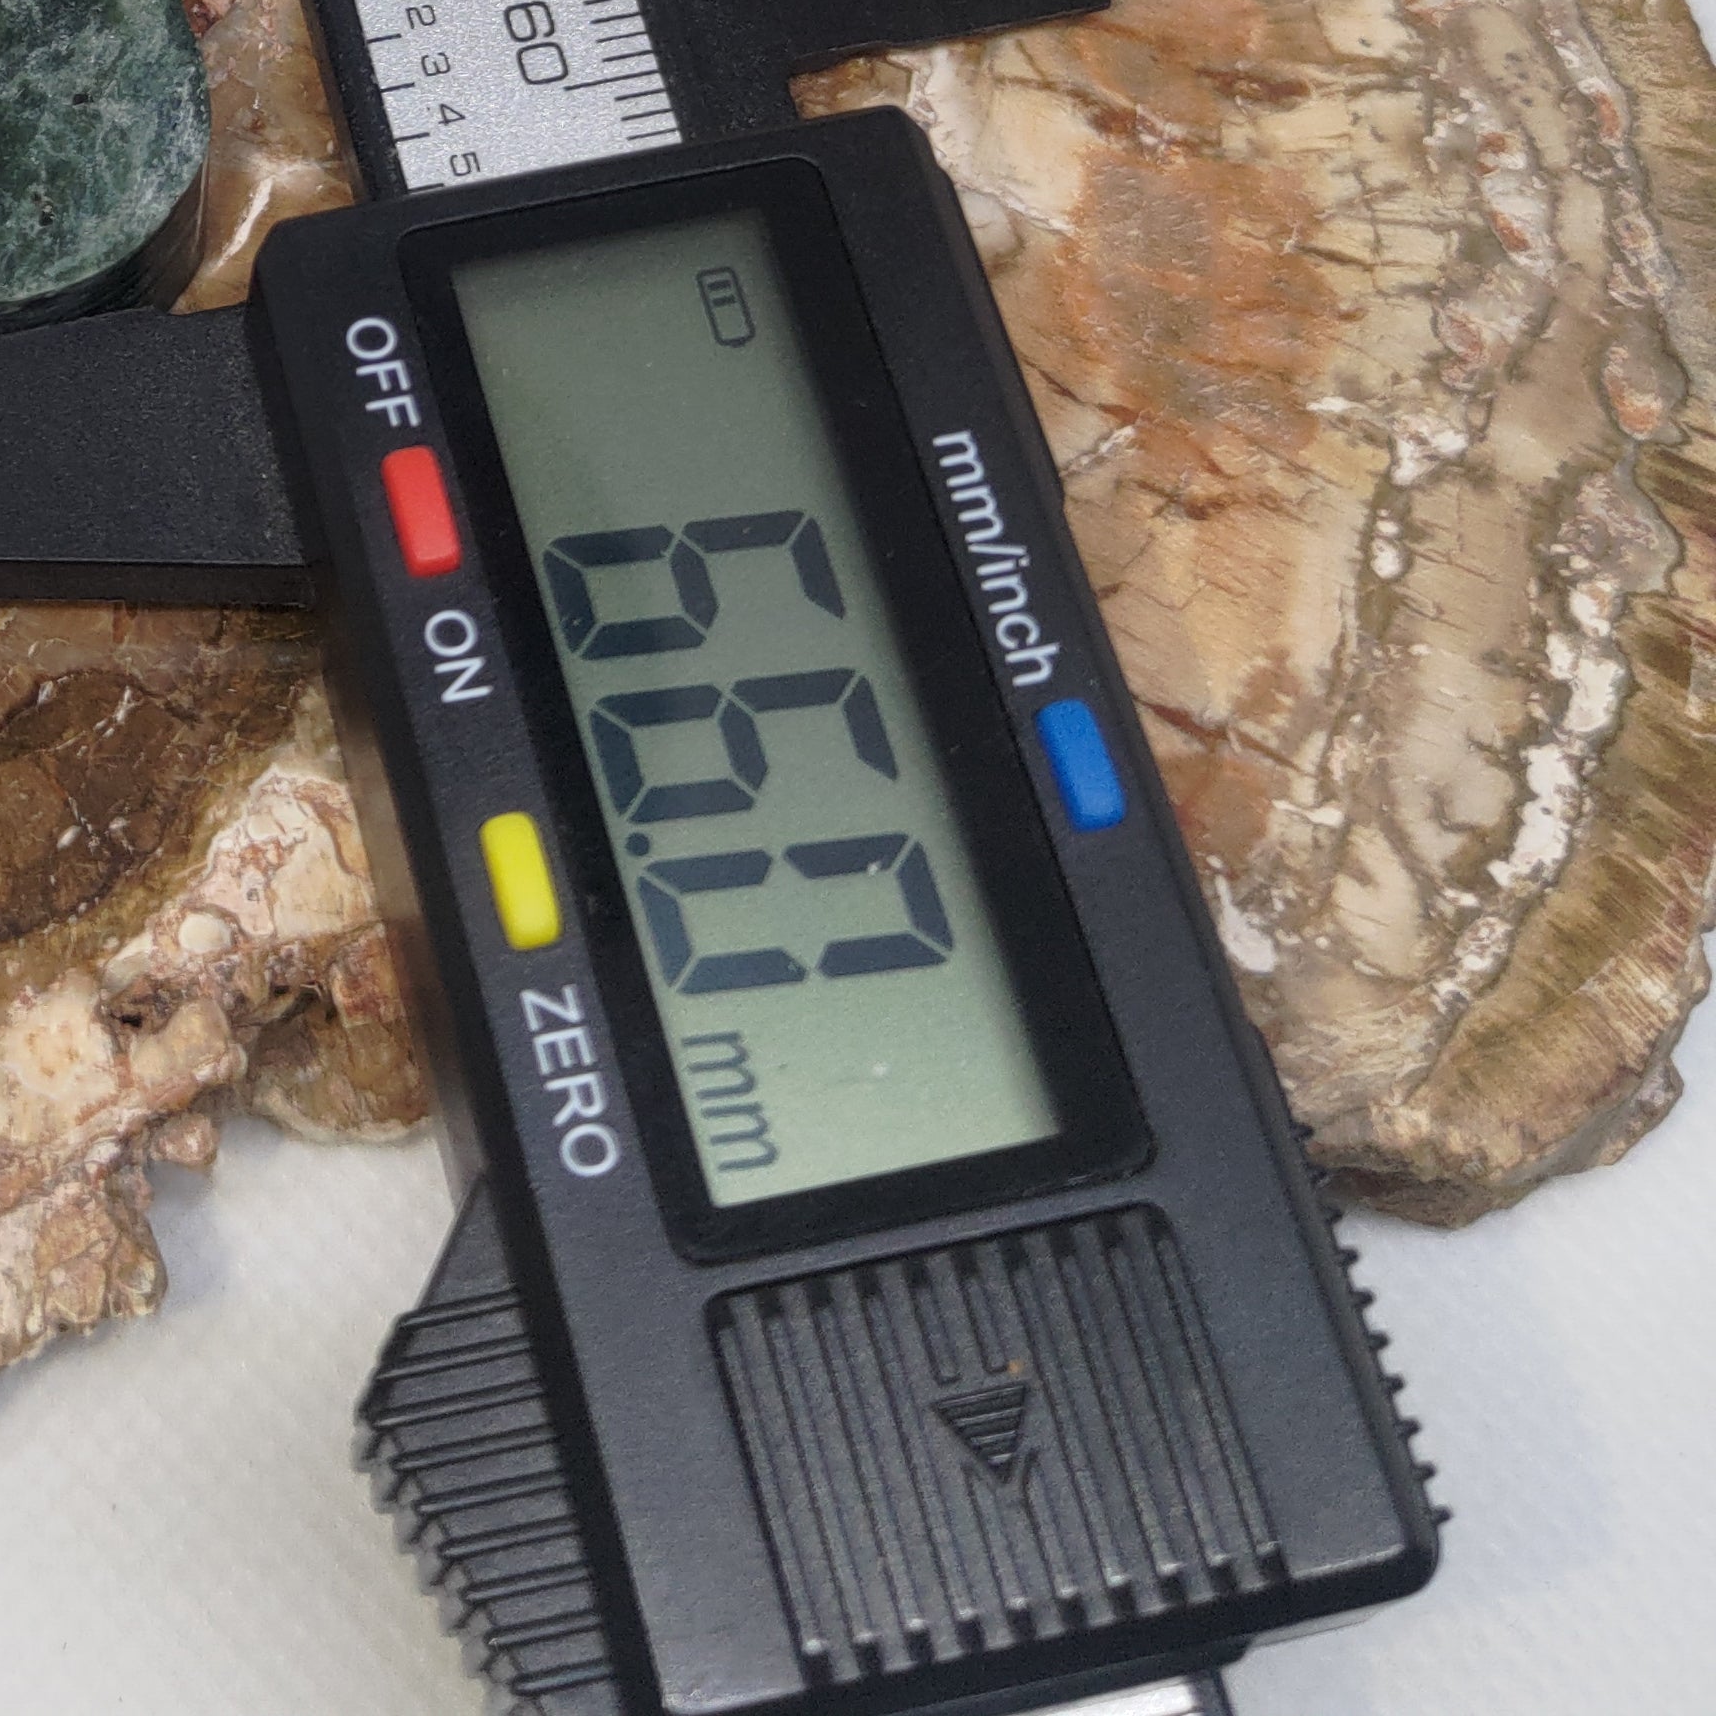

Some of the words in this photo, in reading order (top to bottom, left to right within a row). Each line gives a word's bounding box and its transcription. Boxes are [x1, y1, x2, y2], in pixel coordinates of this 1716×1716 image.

[404, 3, 438, 31] 2
[502, 0, 569, 86] 60
[419, 50, 452, 78] 3
[436, 101, 467, 127] 4
[449, 150, 481, 178] 5
[345, 316, 422, 429] OFF
[932, 429, 1060, 687] mm/inch
[423, 609, 495, 704] ON
[519, 983, 622, 1179] ZERO
[683, 1030, 780, 1174] mm
